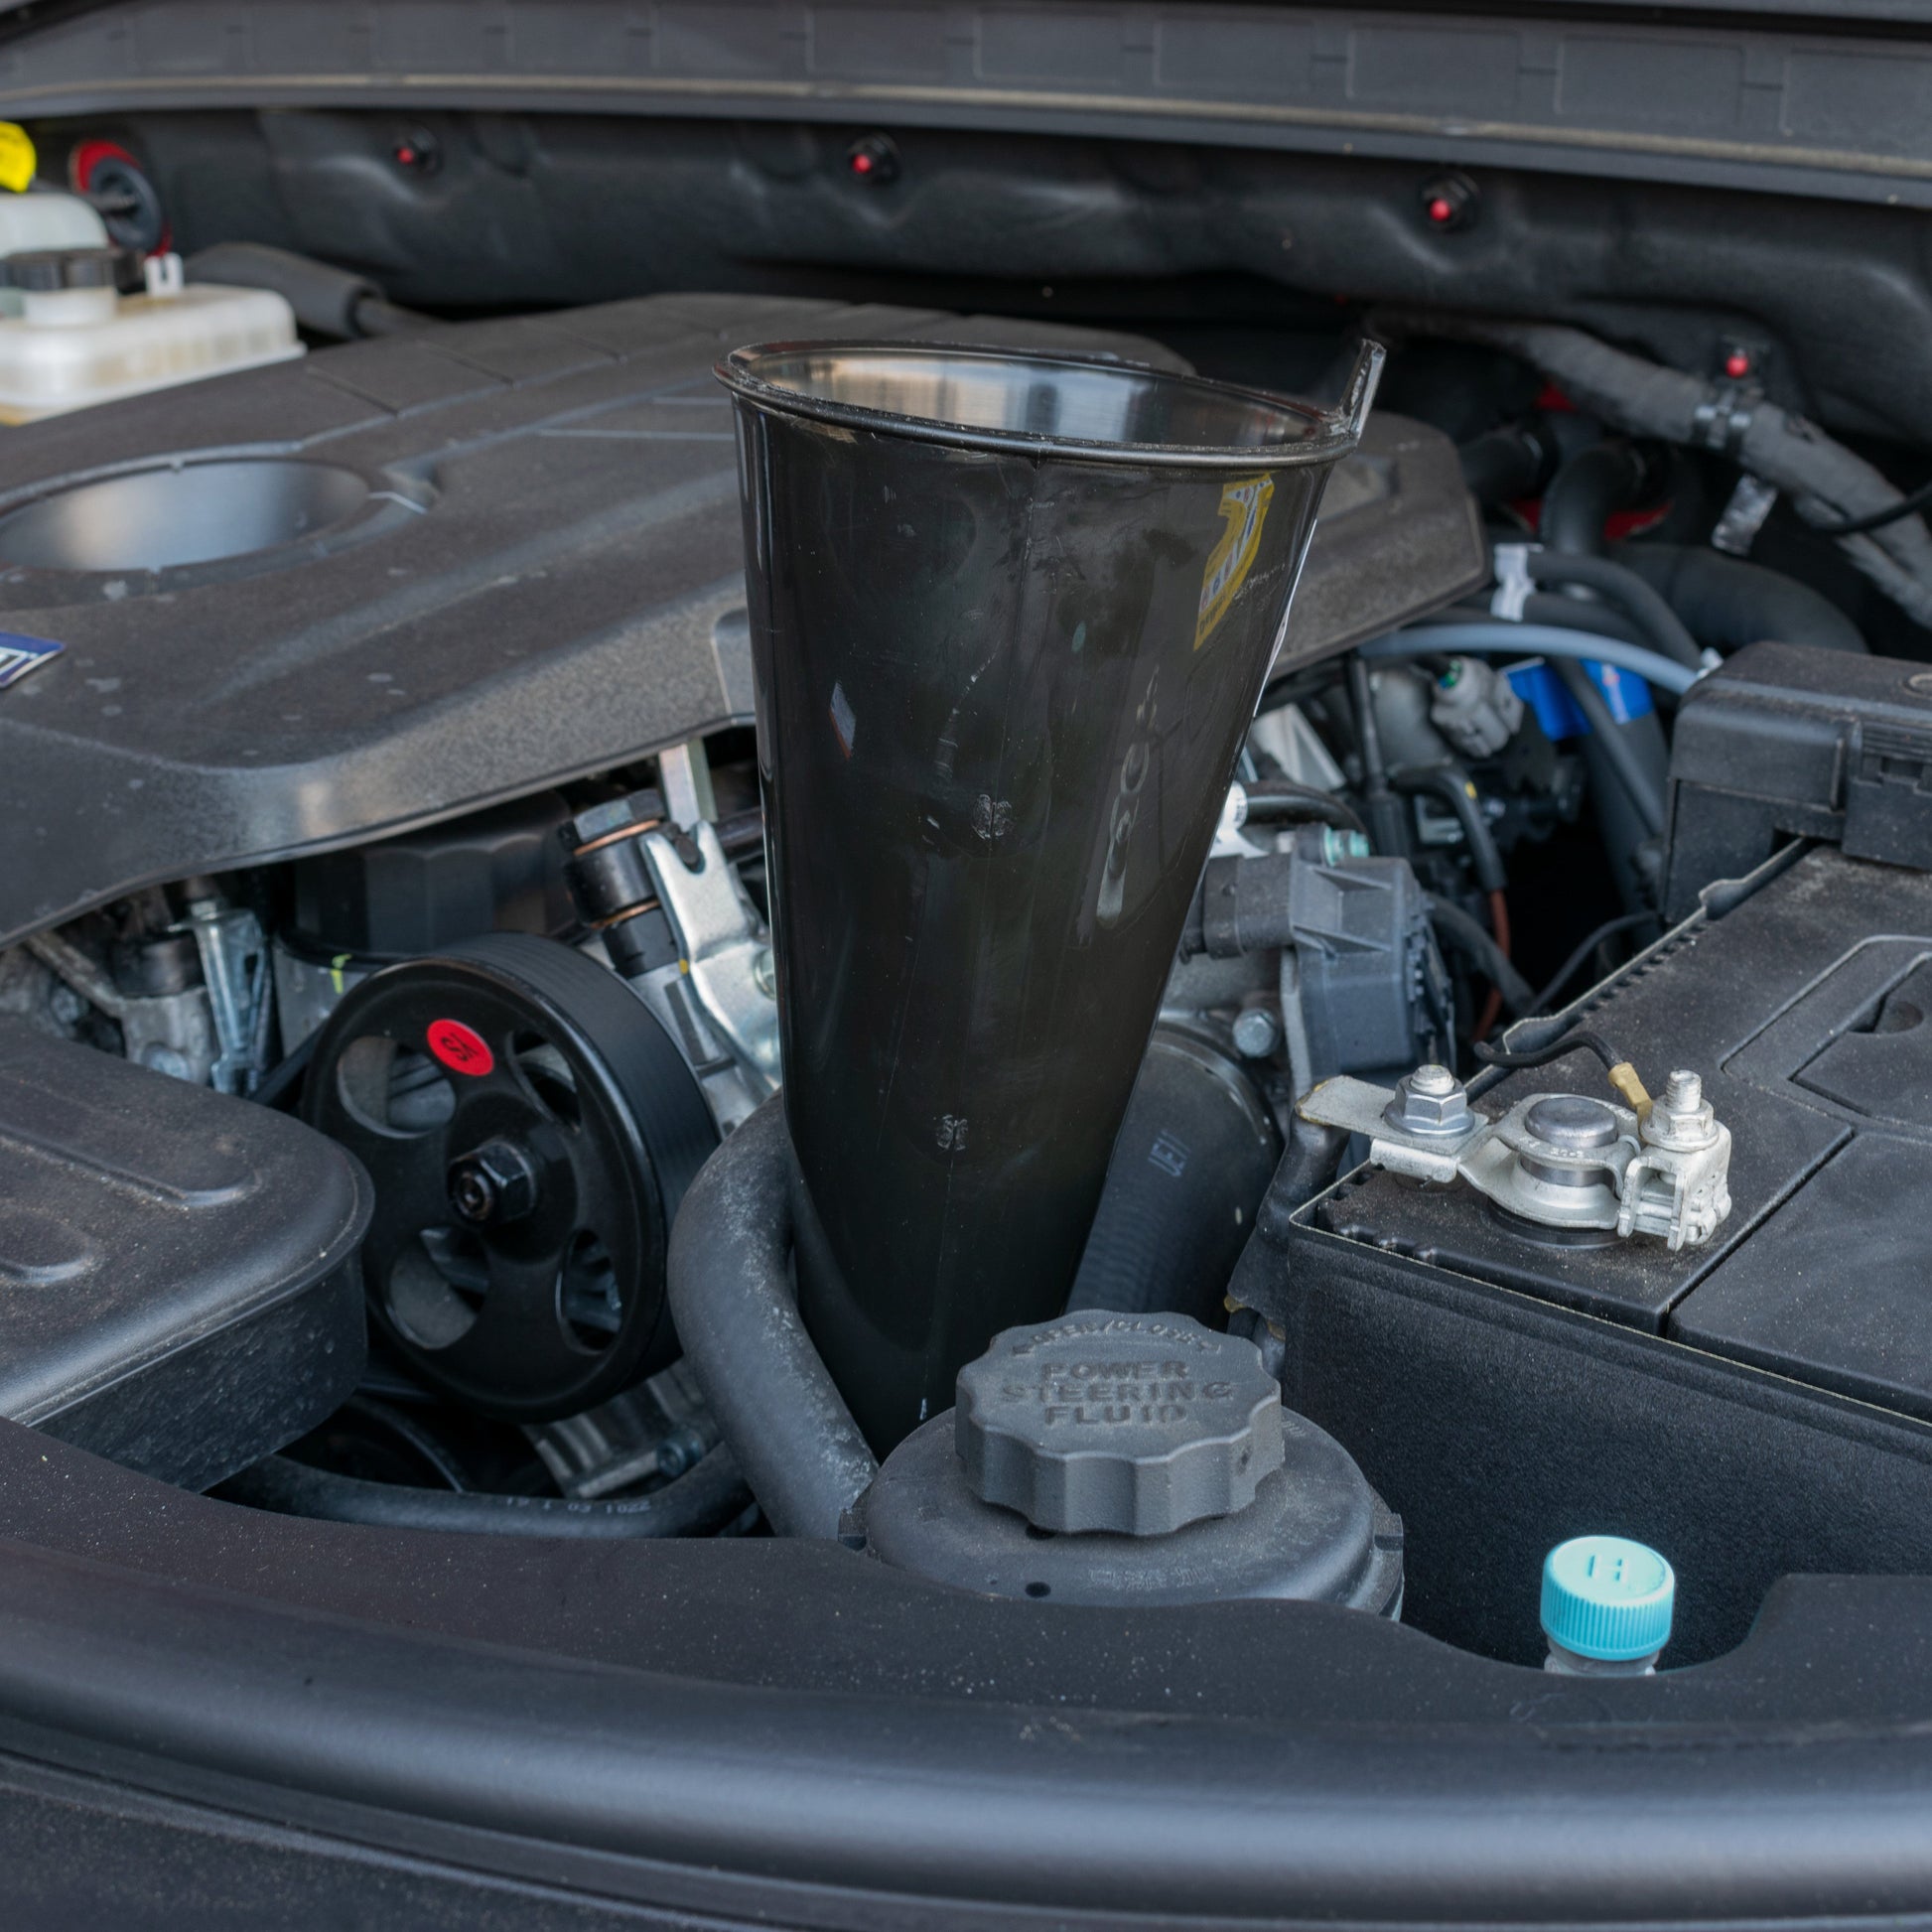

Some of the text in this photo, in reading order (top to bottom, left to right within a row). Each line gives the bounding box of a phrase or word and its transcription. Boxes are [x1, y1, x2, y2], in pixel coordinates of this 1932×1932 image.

[1042, 1360, 1190, 1382] POWER
[1002, 1380, 1233, 1404] STEERING
[1043, 1403, 1189, 1426] FLUID
